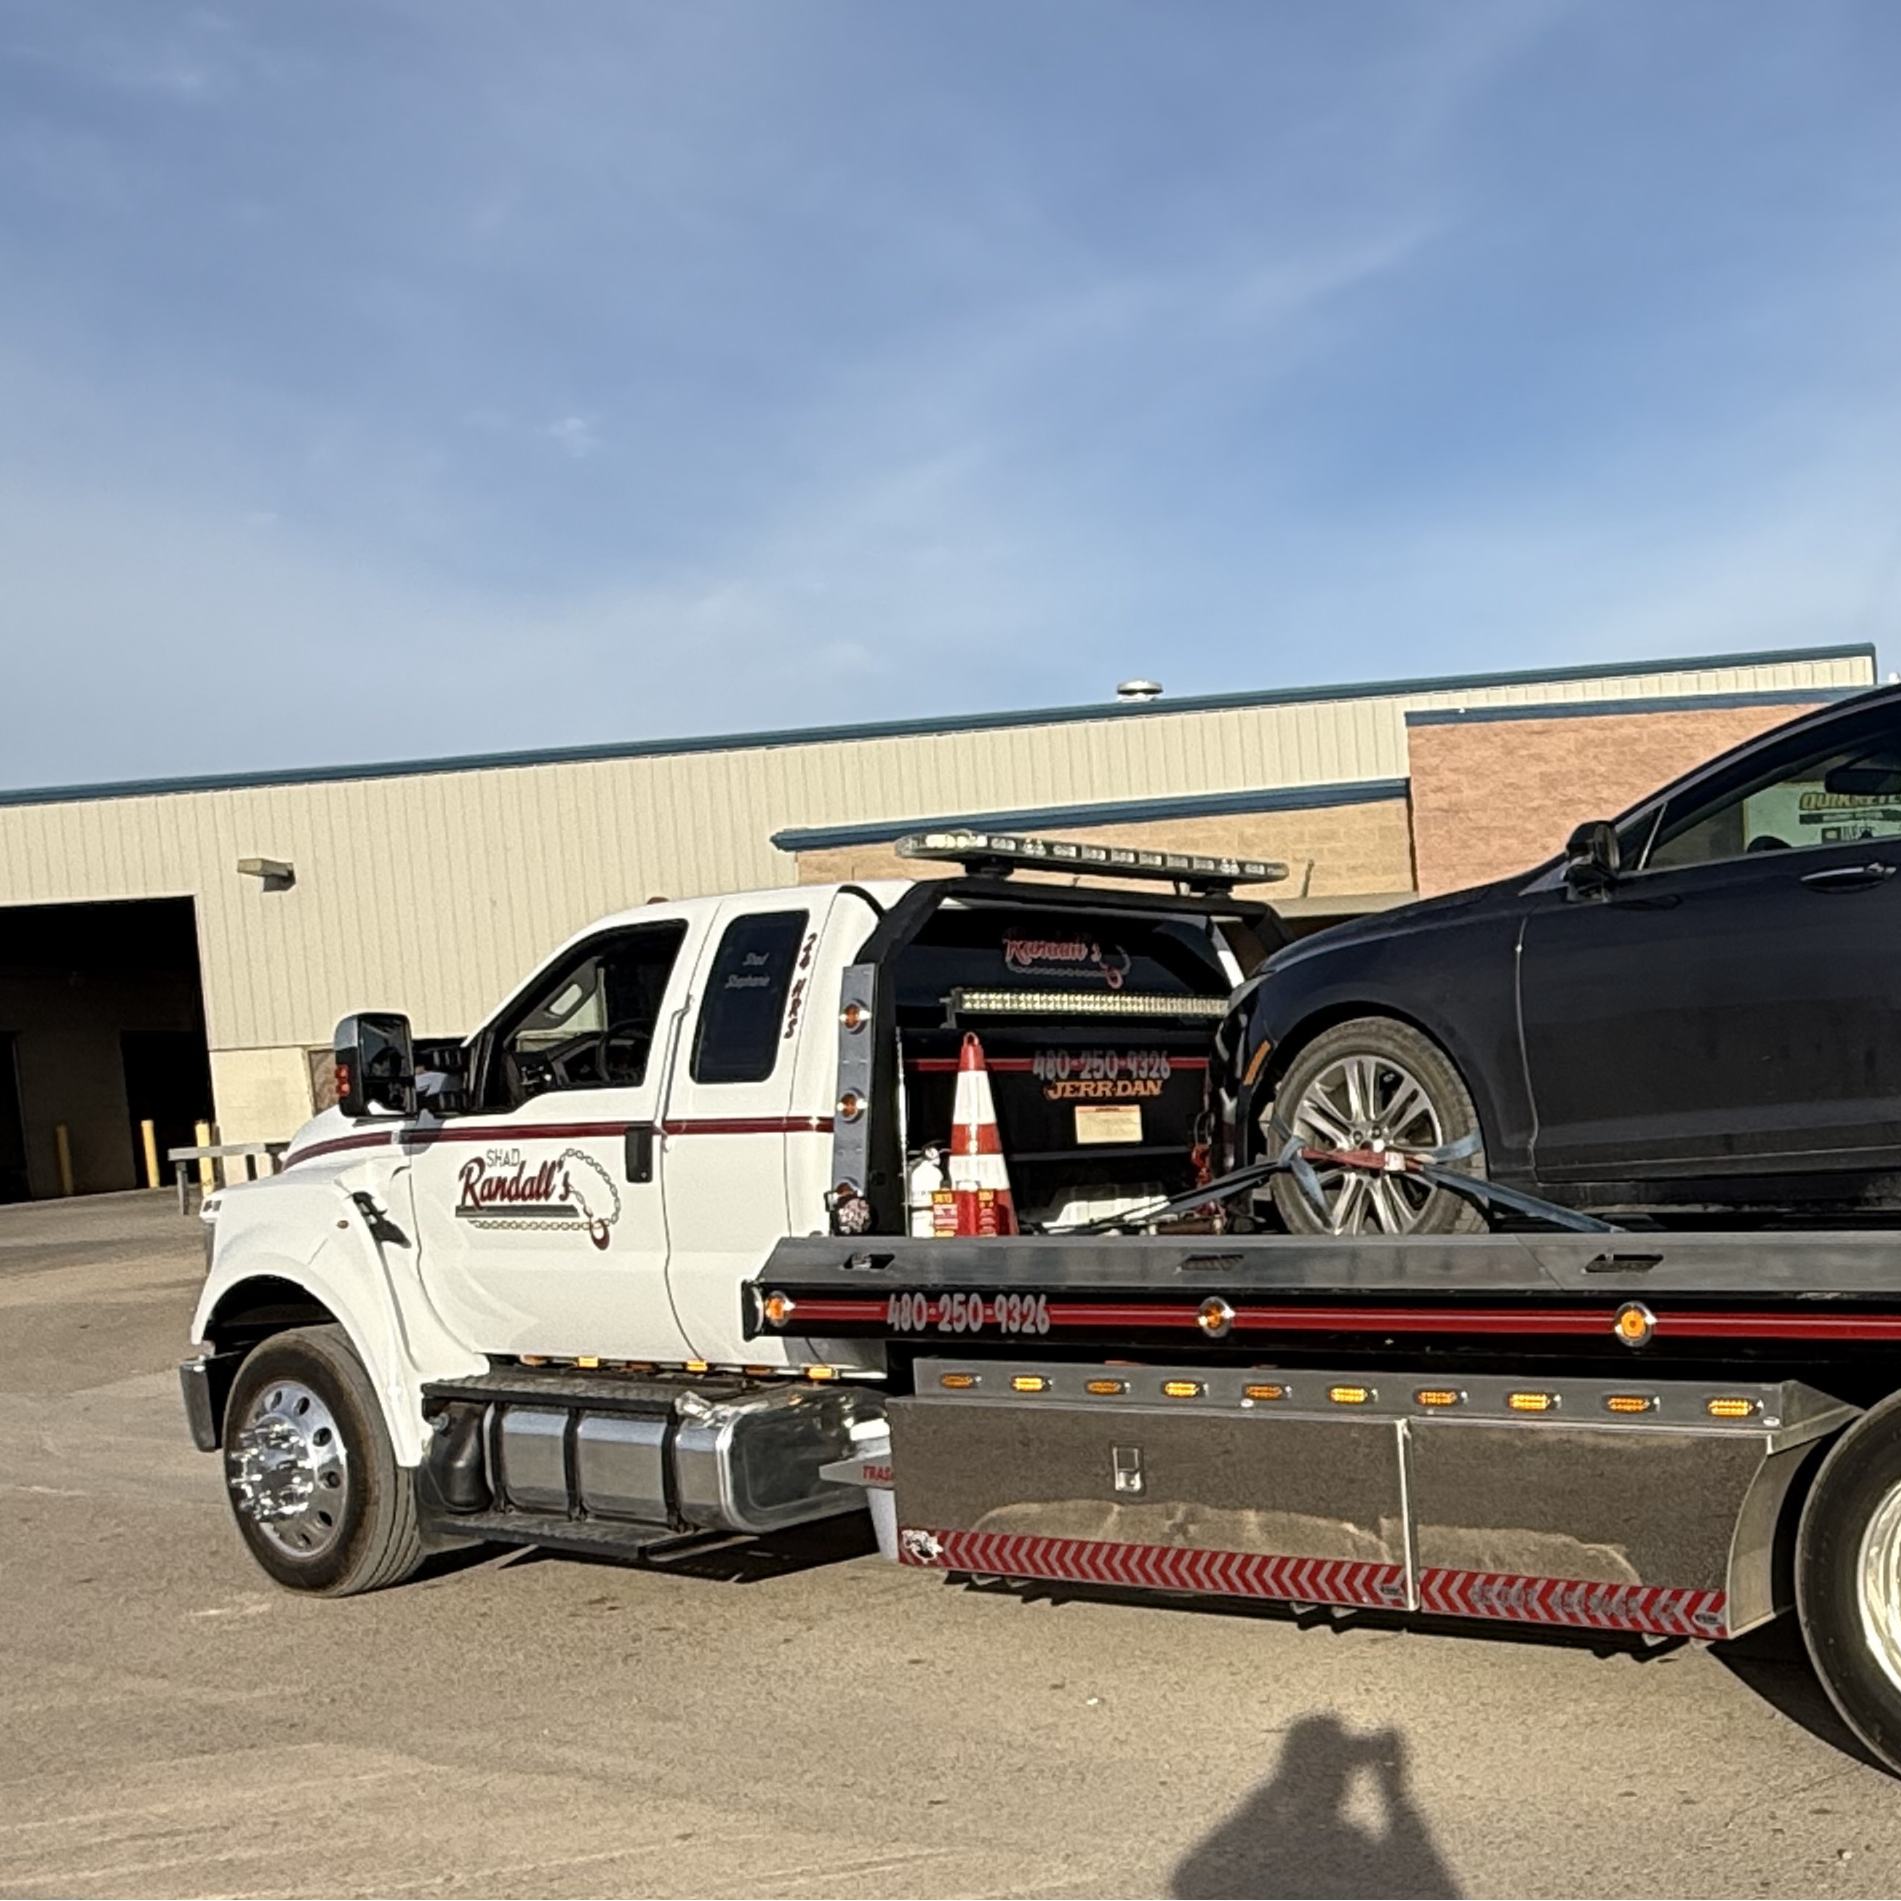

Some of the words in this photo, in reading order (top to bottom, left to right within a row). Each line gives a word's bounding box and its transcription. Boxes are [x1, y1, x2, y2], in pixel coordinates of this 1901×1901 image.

[799, 932, 818, 971] 24
[783, 977, 807, 1039] HRS
[1032, 1049, 1171, 1081] 480-250-9326
[486, 1148, 520, 1168] SHAD
[458, 1156, 570, 1210] Randall's
[886, 1292, 1050, 1335] 480-250-9326
[862, 1464, 895, 1482] TRAS
